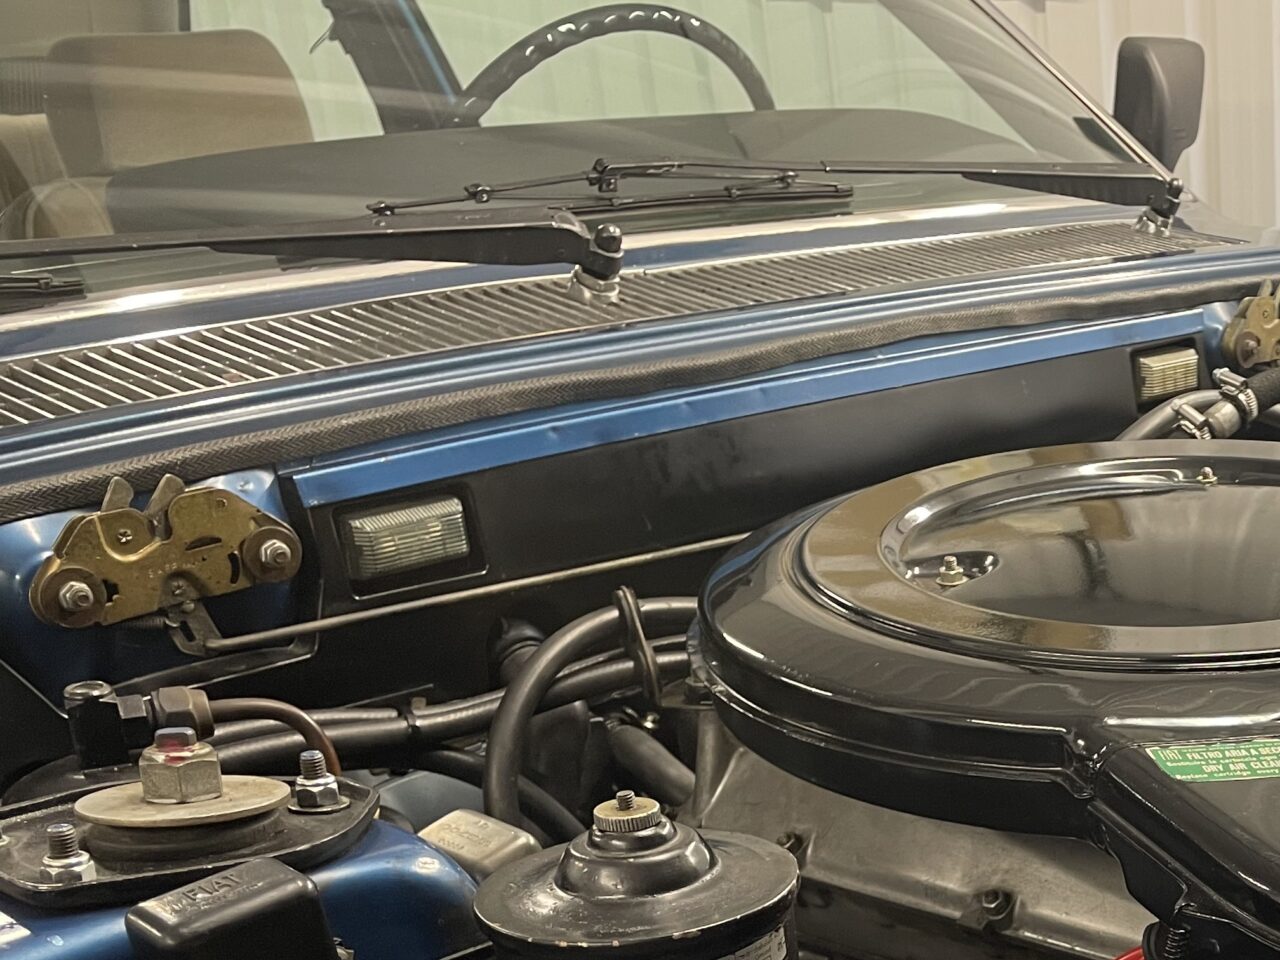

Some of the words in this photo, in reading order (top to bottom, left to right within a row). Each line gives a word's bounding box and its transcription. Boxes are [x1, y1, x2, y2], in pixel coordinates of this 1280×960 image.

[1186, 751, 1223, 760] FILTRO
[1224, 748, 1249, 758] ARIA
[1250, 748, 1259, 756] A
[1202, 764, 1223, 773] DRY
[1229, 762, 1248, 771] AIR
